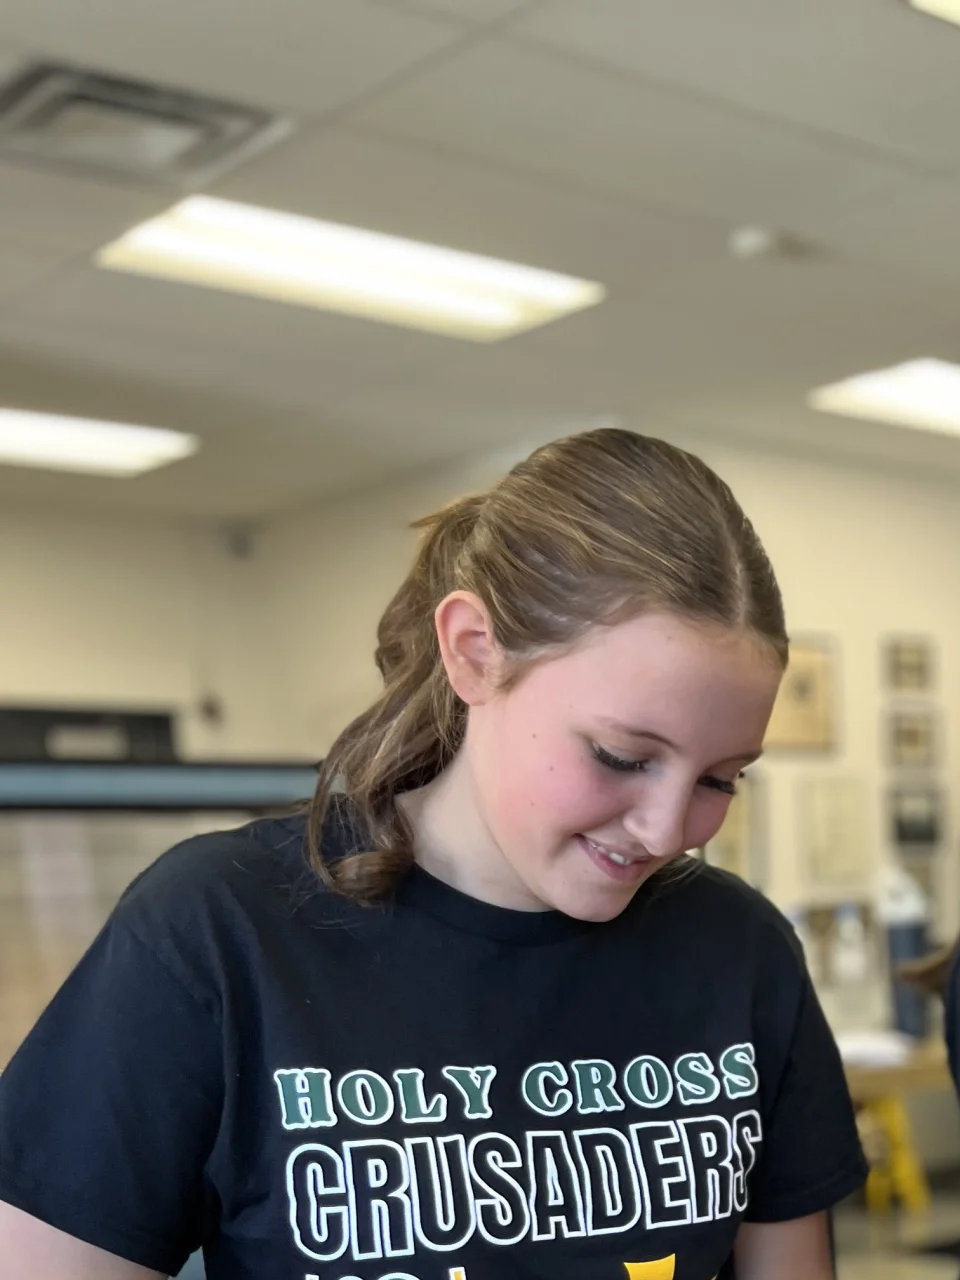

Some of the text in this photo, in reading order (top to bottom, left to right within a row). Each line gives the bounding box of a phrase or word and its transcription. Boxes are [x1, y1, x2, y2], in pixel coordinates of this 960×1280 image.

[275, 1043, 758, 1131] HOLY CROSS
[287, 1110, 763, 1262] CRUSADERS
